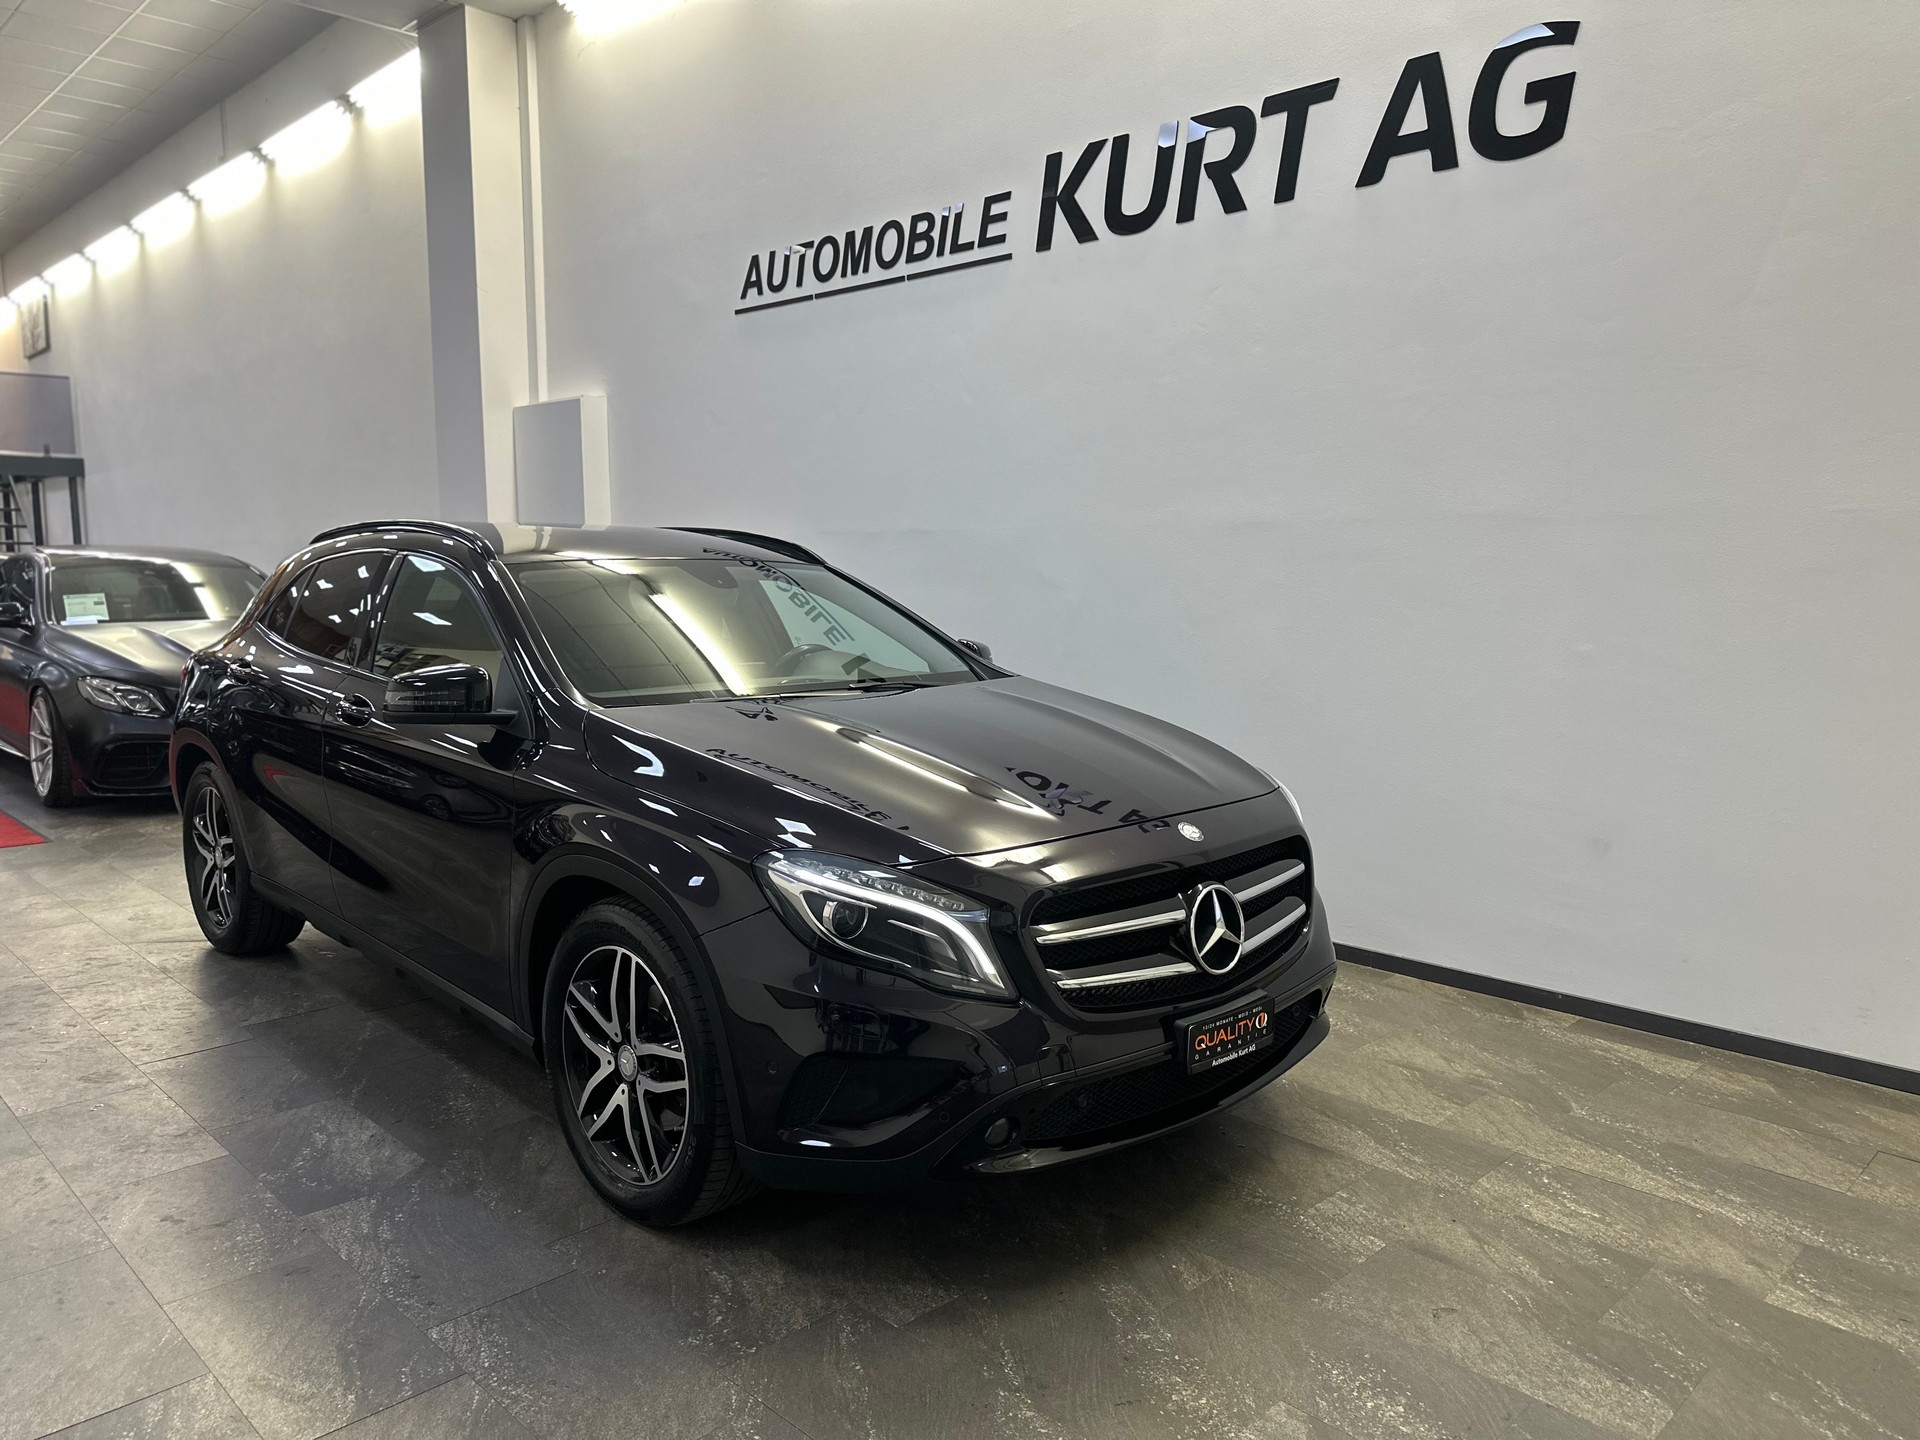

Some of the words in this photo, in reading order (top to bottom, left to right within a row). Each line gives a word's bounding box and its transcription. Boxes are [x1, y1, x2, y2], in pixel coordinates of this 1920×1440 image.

[739, 190, 1012, 301] AUTOMOBILE
[1036, 77, 1340, 253] KURT
[1355, 20, 1581, 189] AG
[1195, 1028, 1267, 1060] GARANTIE
[1211, 1053, 1238, 1067] Automobile
[1238, 1047, 1249, 1057] Kurt
[1248, 1044, 1256, 1052] AG
